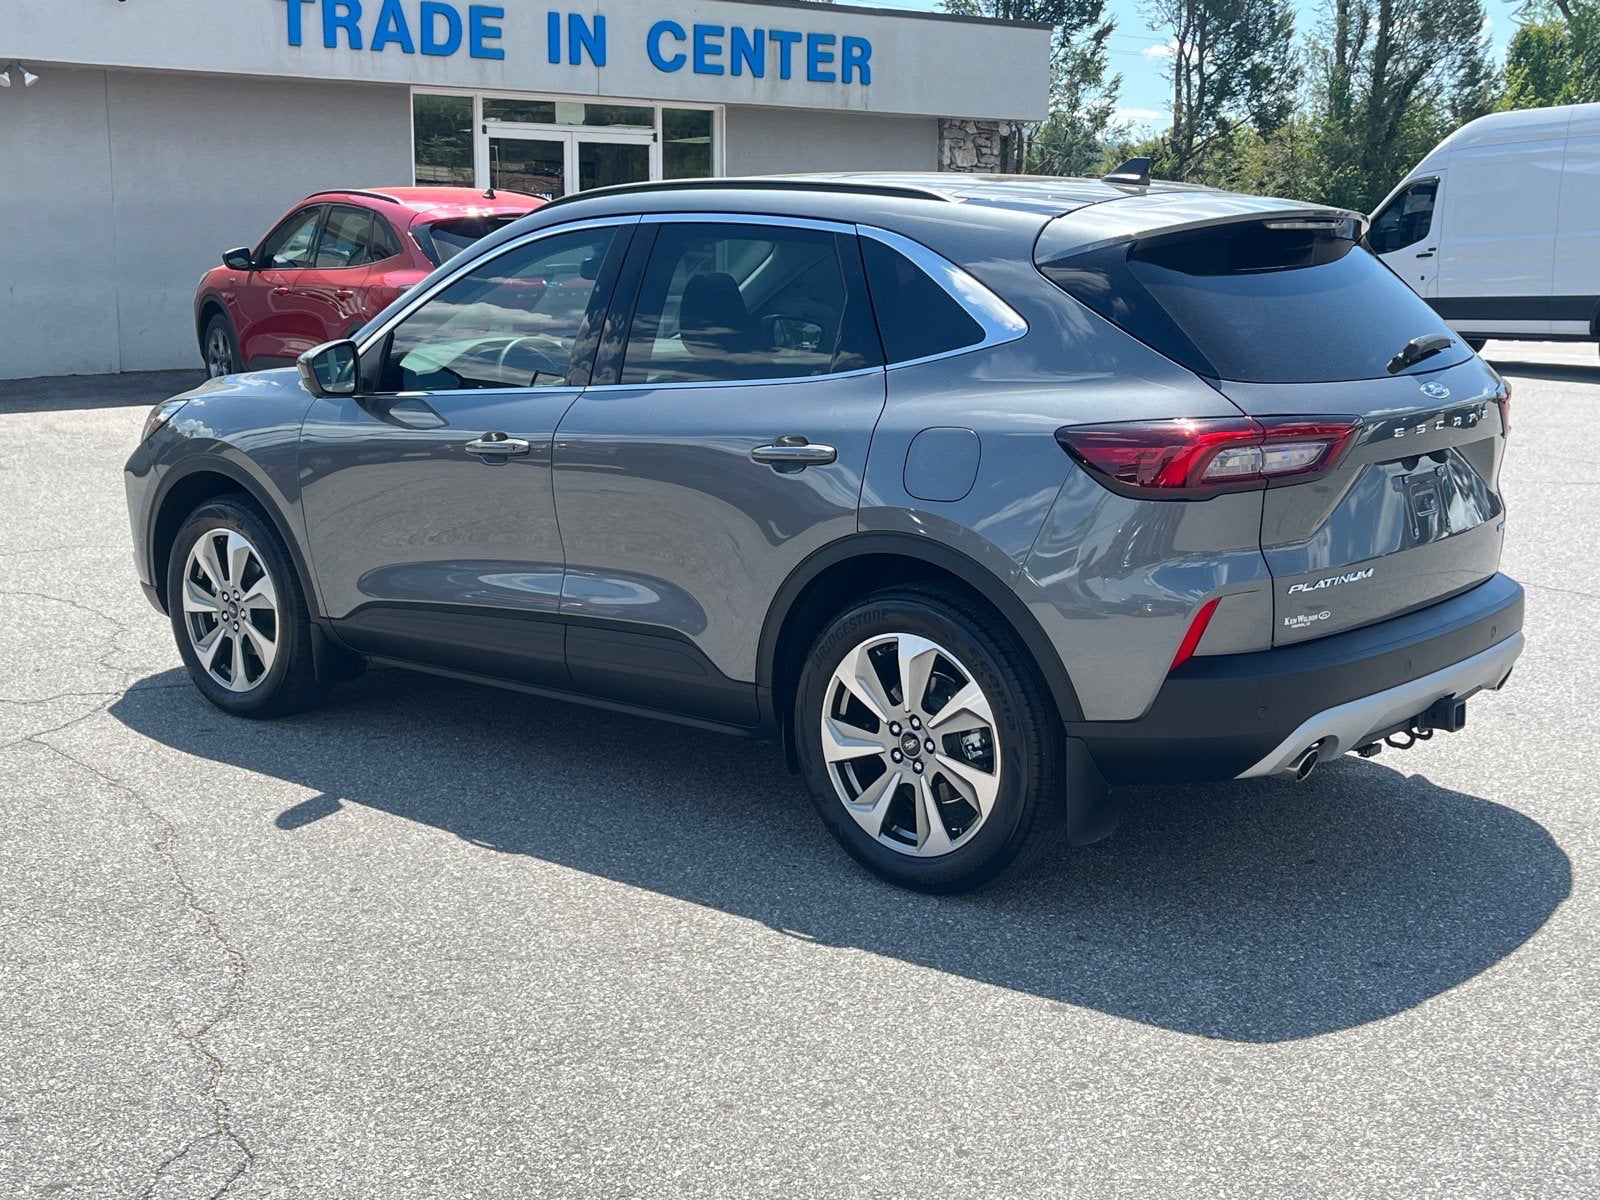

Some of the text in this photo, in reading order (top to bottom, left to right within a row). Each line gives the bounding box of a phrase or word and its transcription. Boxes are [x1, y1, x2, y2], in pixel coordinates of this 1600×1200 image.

[284, 0, 871, 85] TRADE IN CENTER
[1394, 409, 1488, 437] ESCAPE
[1287, 568, 1374, 594] PLATINUM
